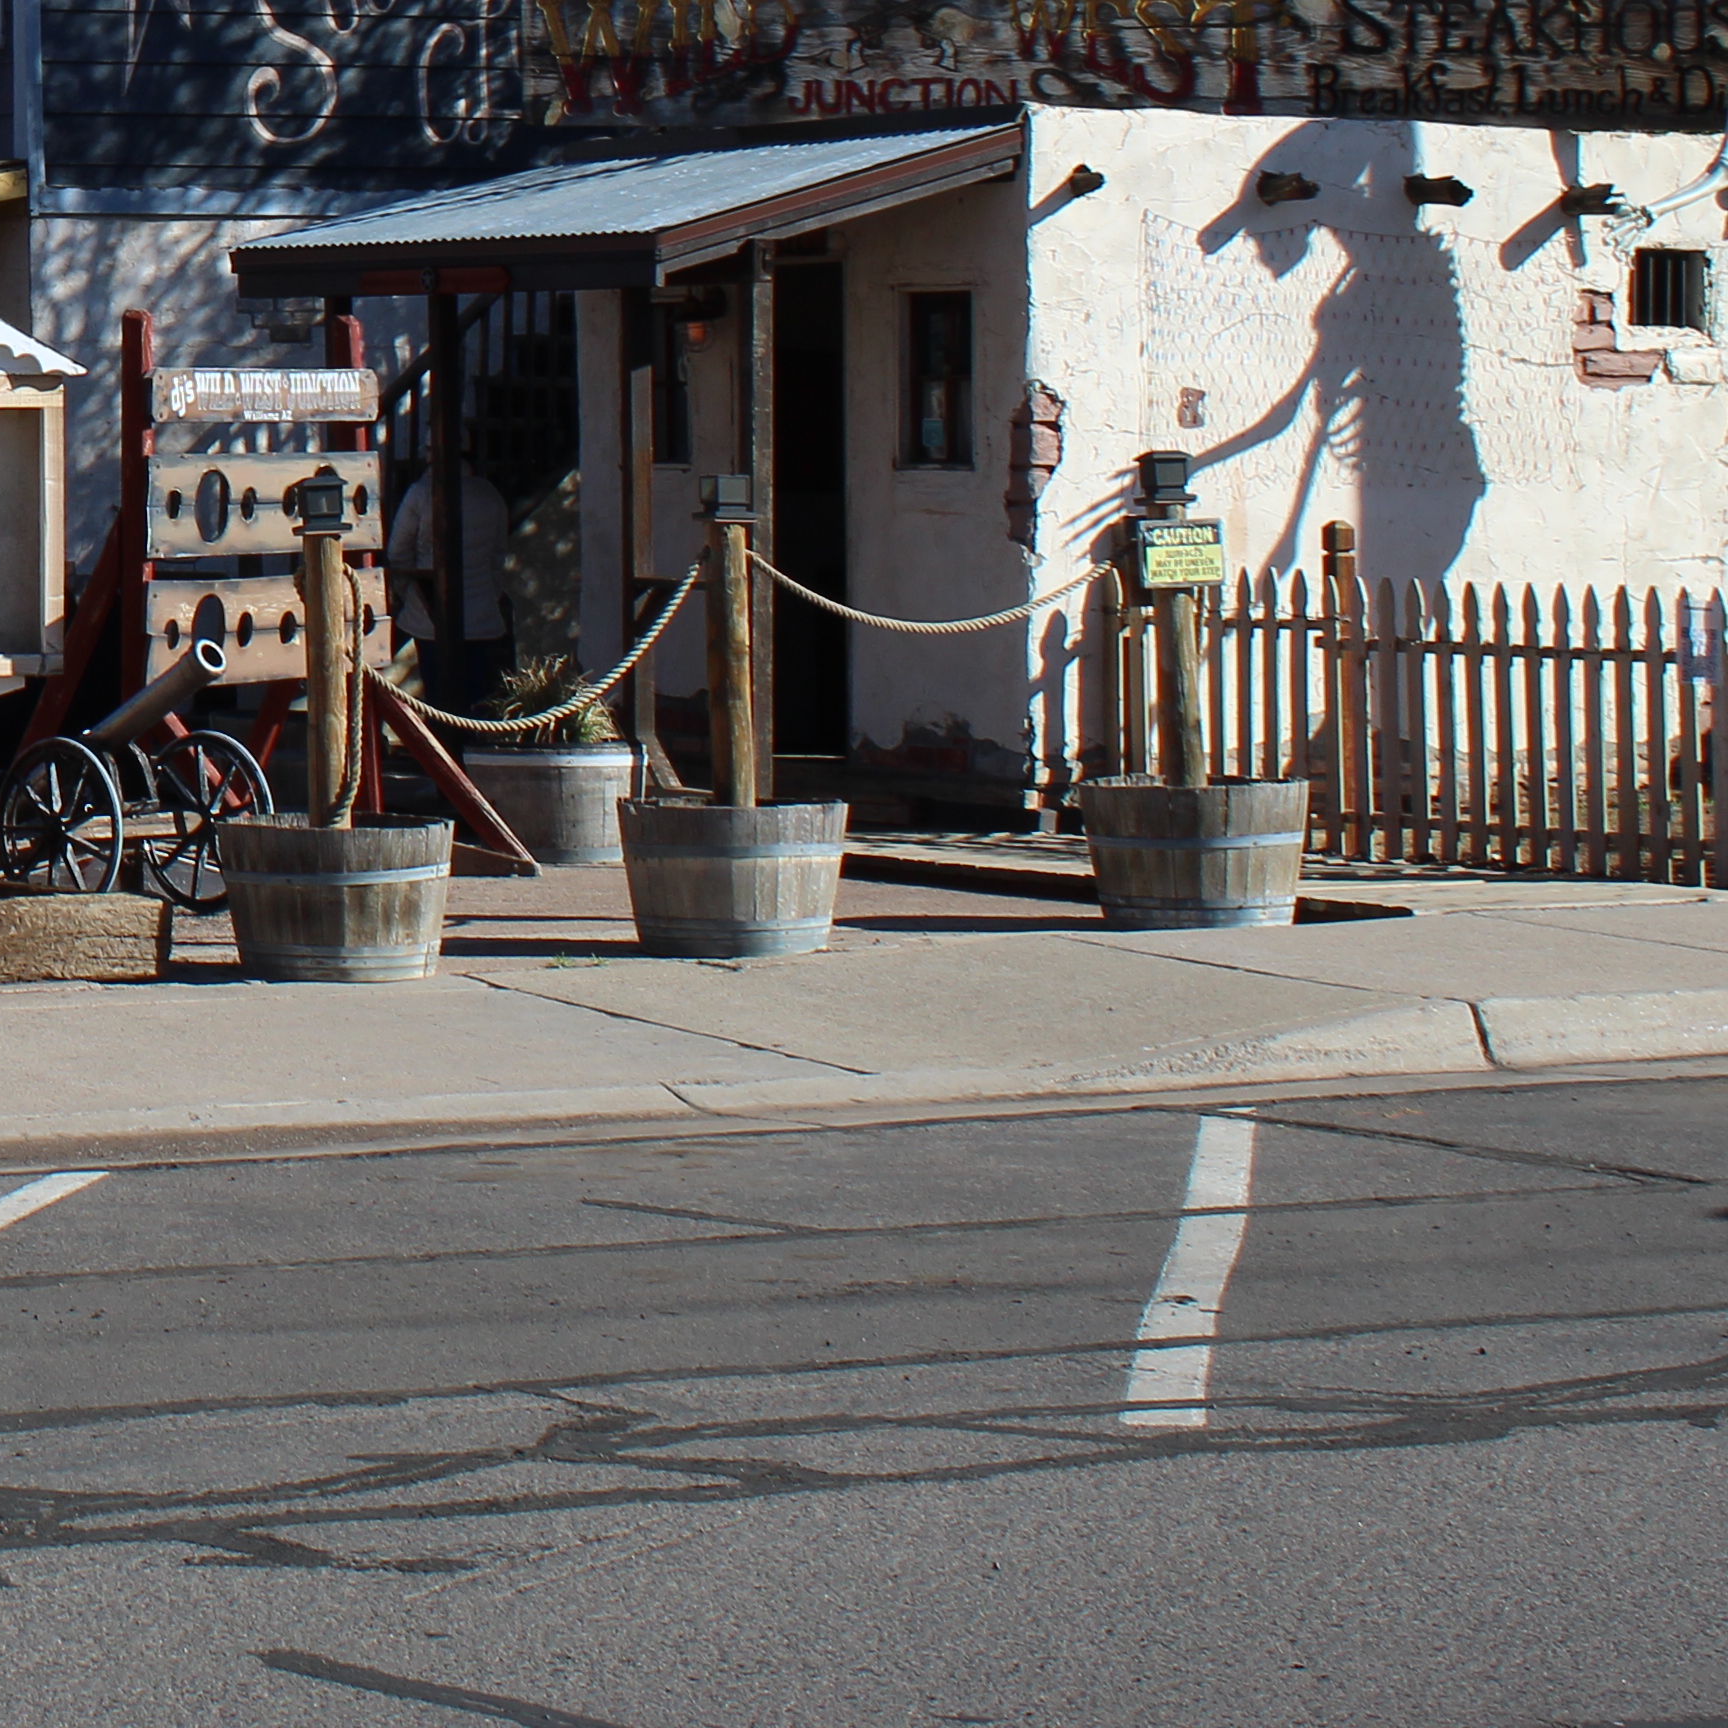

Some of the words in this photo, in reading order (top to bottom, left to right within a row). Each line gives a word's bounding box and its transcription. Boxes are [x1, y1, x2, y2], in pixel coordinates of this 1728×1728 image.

[789, 76, 1019, 115] JUNCTION
[1514, 63, 1643, 116] Lunch
[240, 371, 283, 410] WEST
[289, 371, 362, 410] JUNCTION
[1152, 526, 1213, 546] CAUTION
